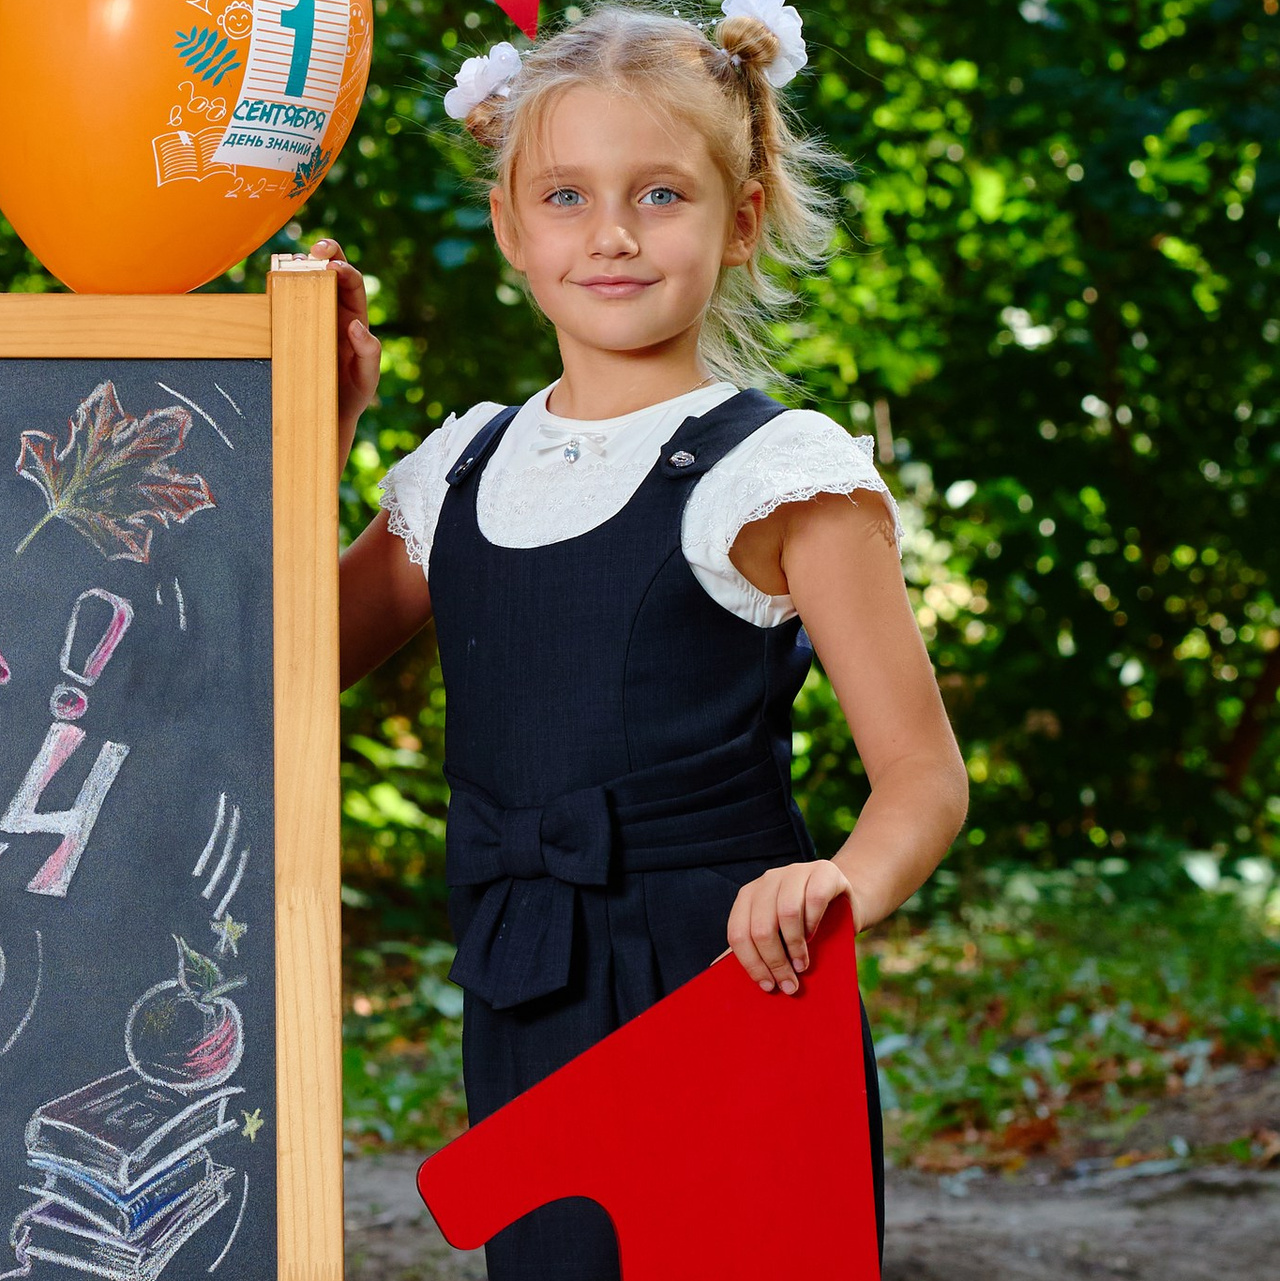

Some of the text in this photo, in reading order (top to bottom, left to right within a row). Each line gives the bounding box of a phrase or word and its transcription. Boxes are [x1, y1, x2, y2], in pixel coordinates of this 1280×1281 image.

[233, 100, 327, 133] СЕНТЯБРЯ
[223, 133, 313, 157] ДЕНЬ ЗНАНИЙ
